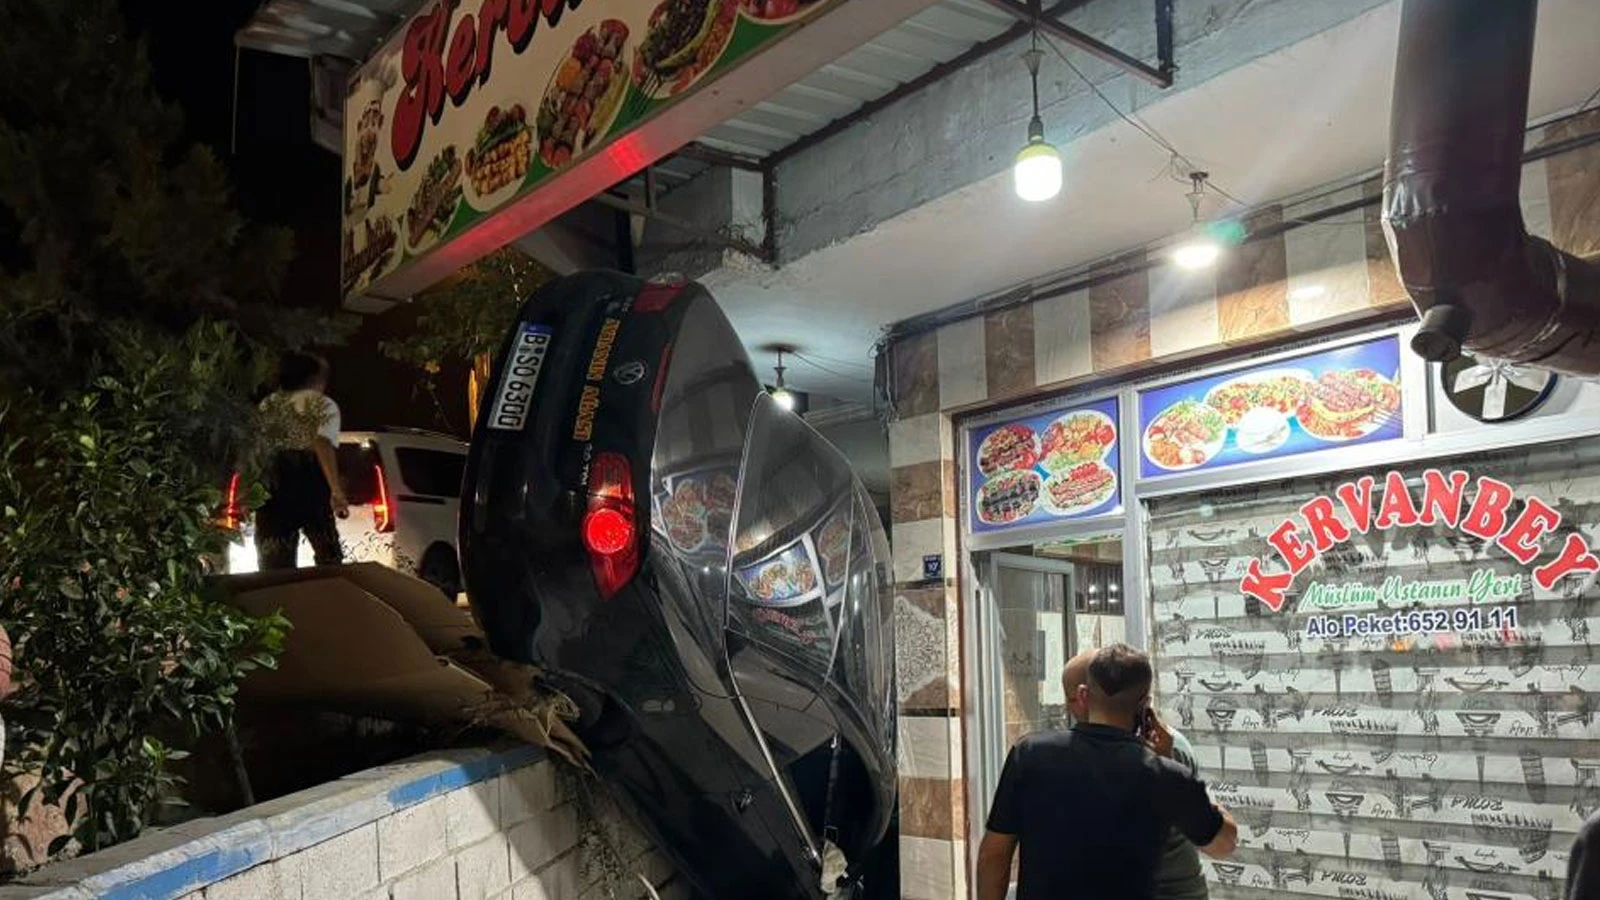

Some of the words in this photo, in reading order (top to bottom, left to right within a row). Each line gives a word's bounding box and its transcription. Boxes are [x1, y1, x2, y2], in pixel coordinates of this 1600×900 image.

[524, 333, 546, 345] B
[498, 381, 533, 428] 6300
[1241, 469, 1599, 611] KERVANBEY
[1301, 581, 1376, 611] Müslüm
[1382, 576, 1460, 600] Ustanın
[1467, 570, 1520, 601] Yeri
[1307, 617, 1338, 635] Alo
[1345, 610, 1448, 633] Peket:652
[1455, 610, 1479, 630] 91
[1491, 607, 1516, 628] 11
[1450, 797, 1503, 810] ROMA
[1321, 872, 1368, 886] ROMA
